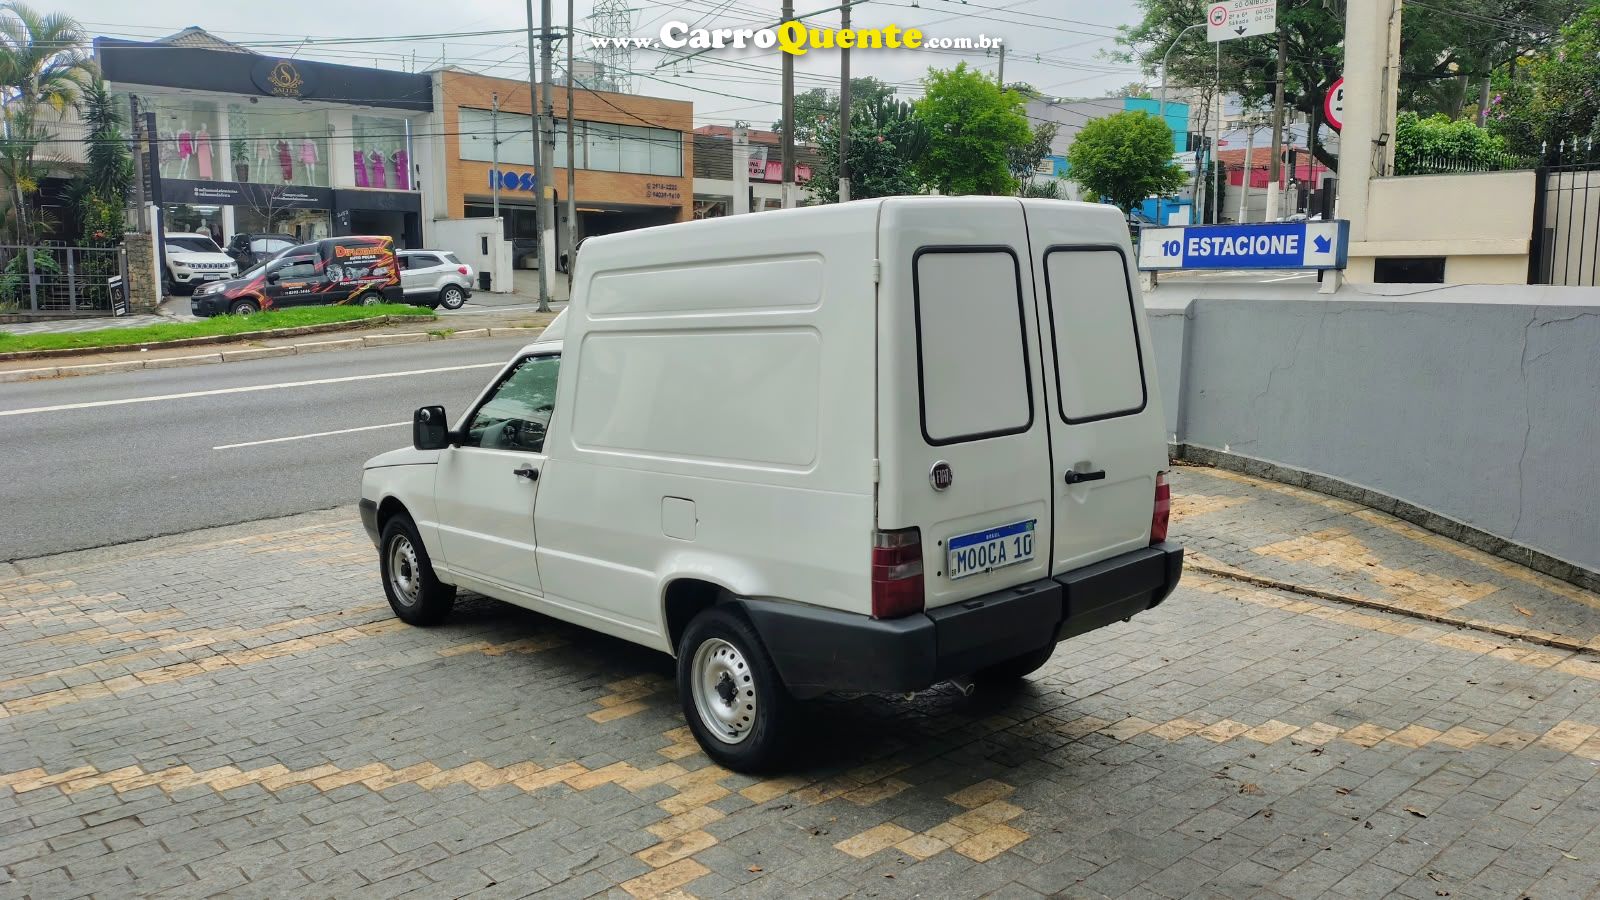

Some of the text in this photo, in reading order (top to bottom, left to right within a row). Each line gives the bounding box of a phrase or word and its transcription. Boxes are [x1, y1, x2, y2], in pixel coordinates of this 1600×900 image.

[1162, 234, 1299, 257] 10 ESTACIONE
[936, 469, 949, 484] FIAT
[957, 533, 1032, 574] MOOCA 10
